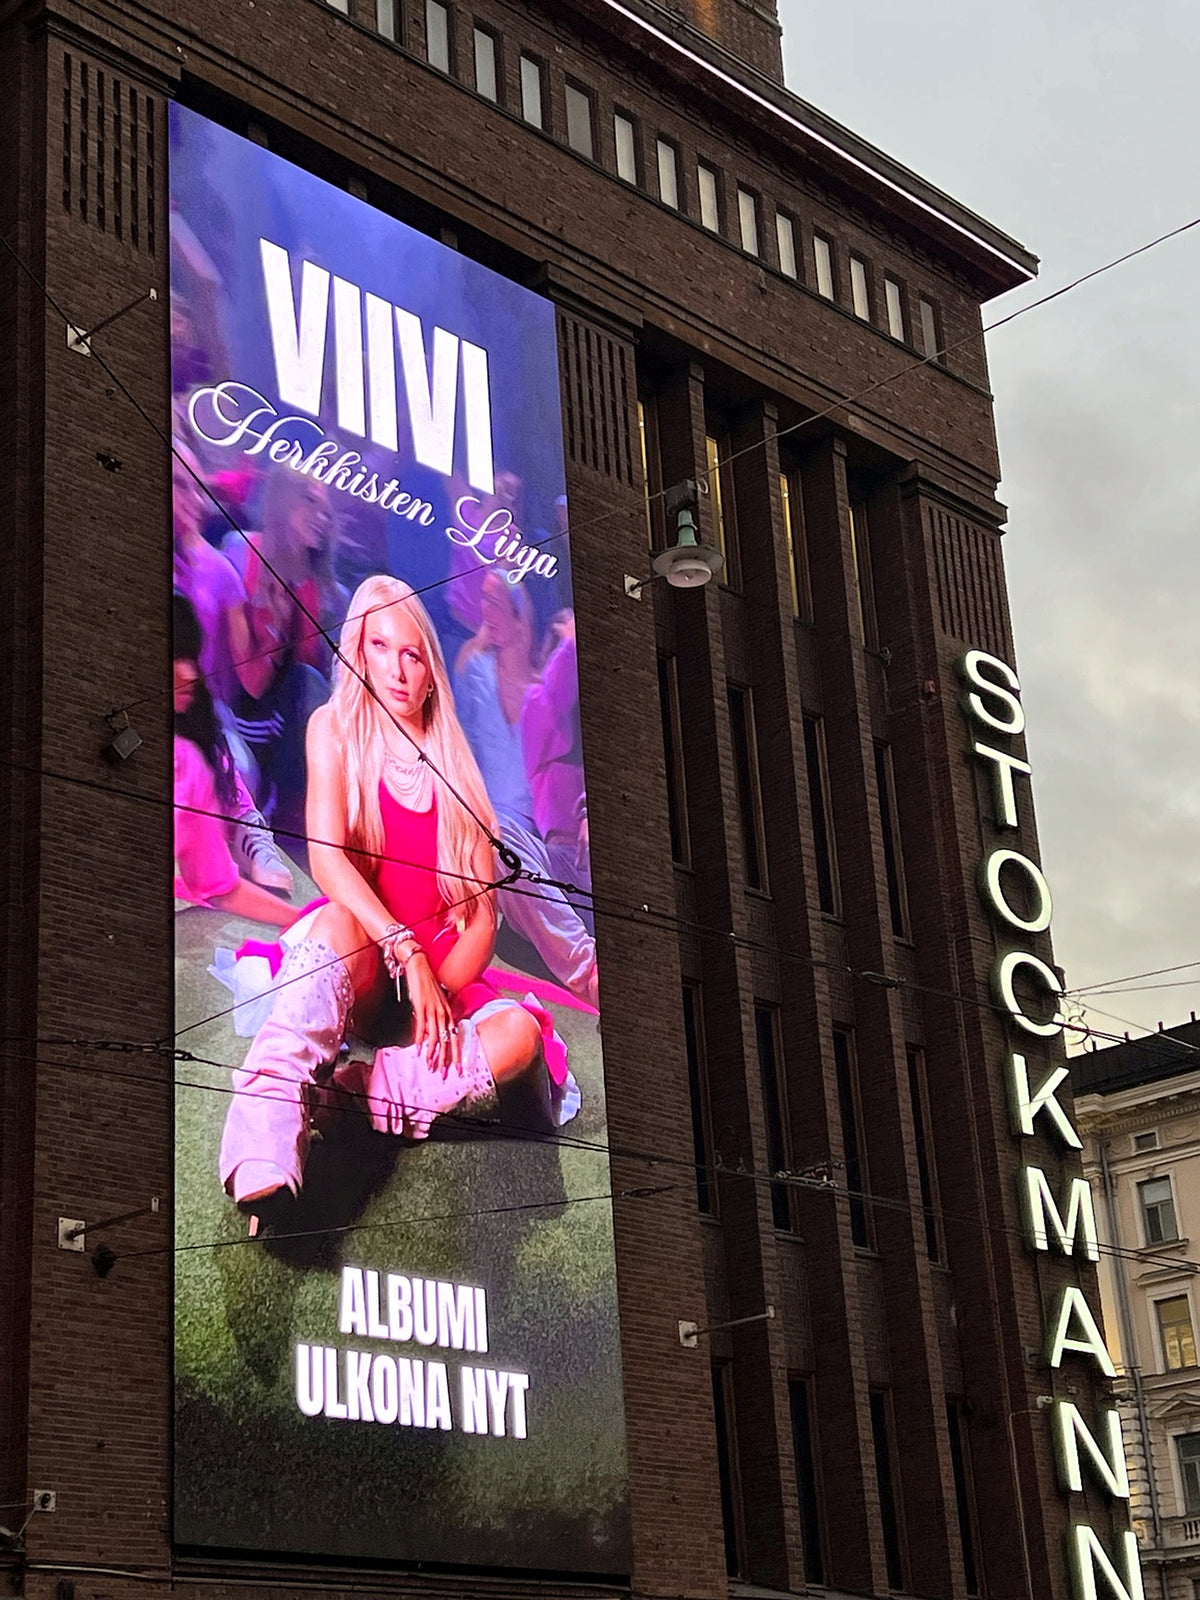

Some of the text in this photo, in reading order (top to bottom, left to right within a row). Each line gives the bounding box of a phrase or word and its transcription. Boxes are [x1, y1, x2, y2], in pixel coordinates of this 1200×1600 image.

[260, 237, 494, 495] VIIVI
[188, 381, 558, 584] Herkkisten Liiga
[964, 649, 1144, 1600] STOCKMANN
[297, 1344, 529, 1440] ULKONA NYT
[340, 1266, 488, 1353] ALBUMI
